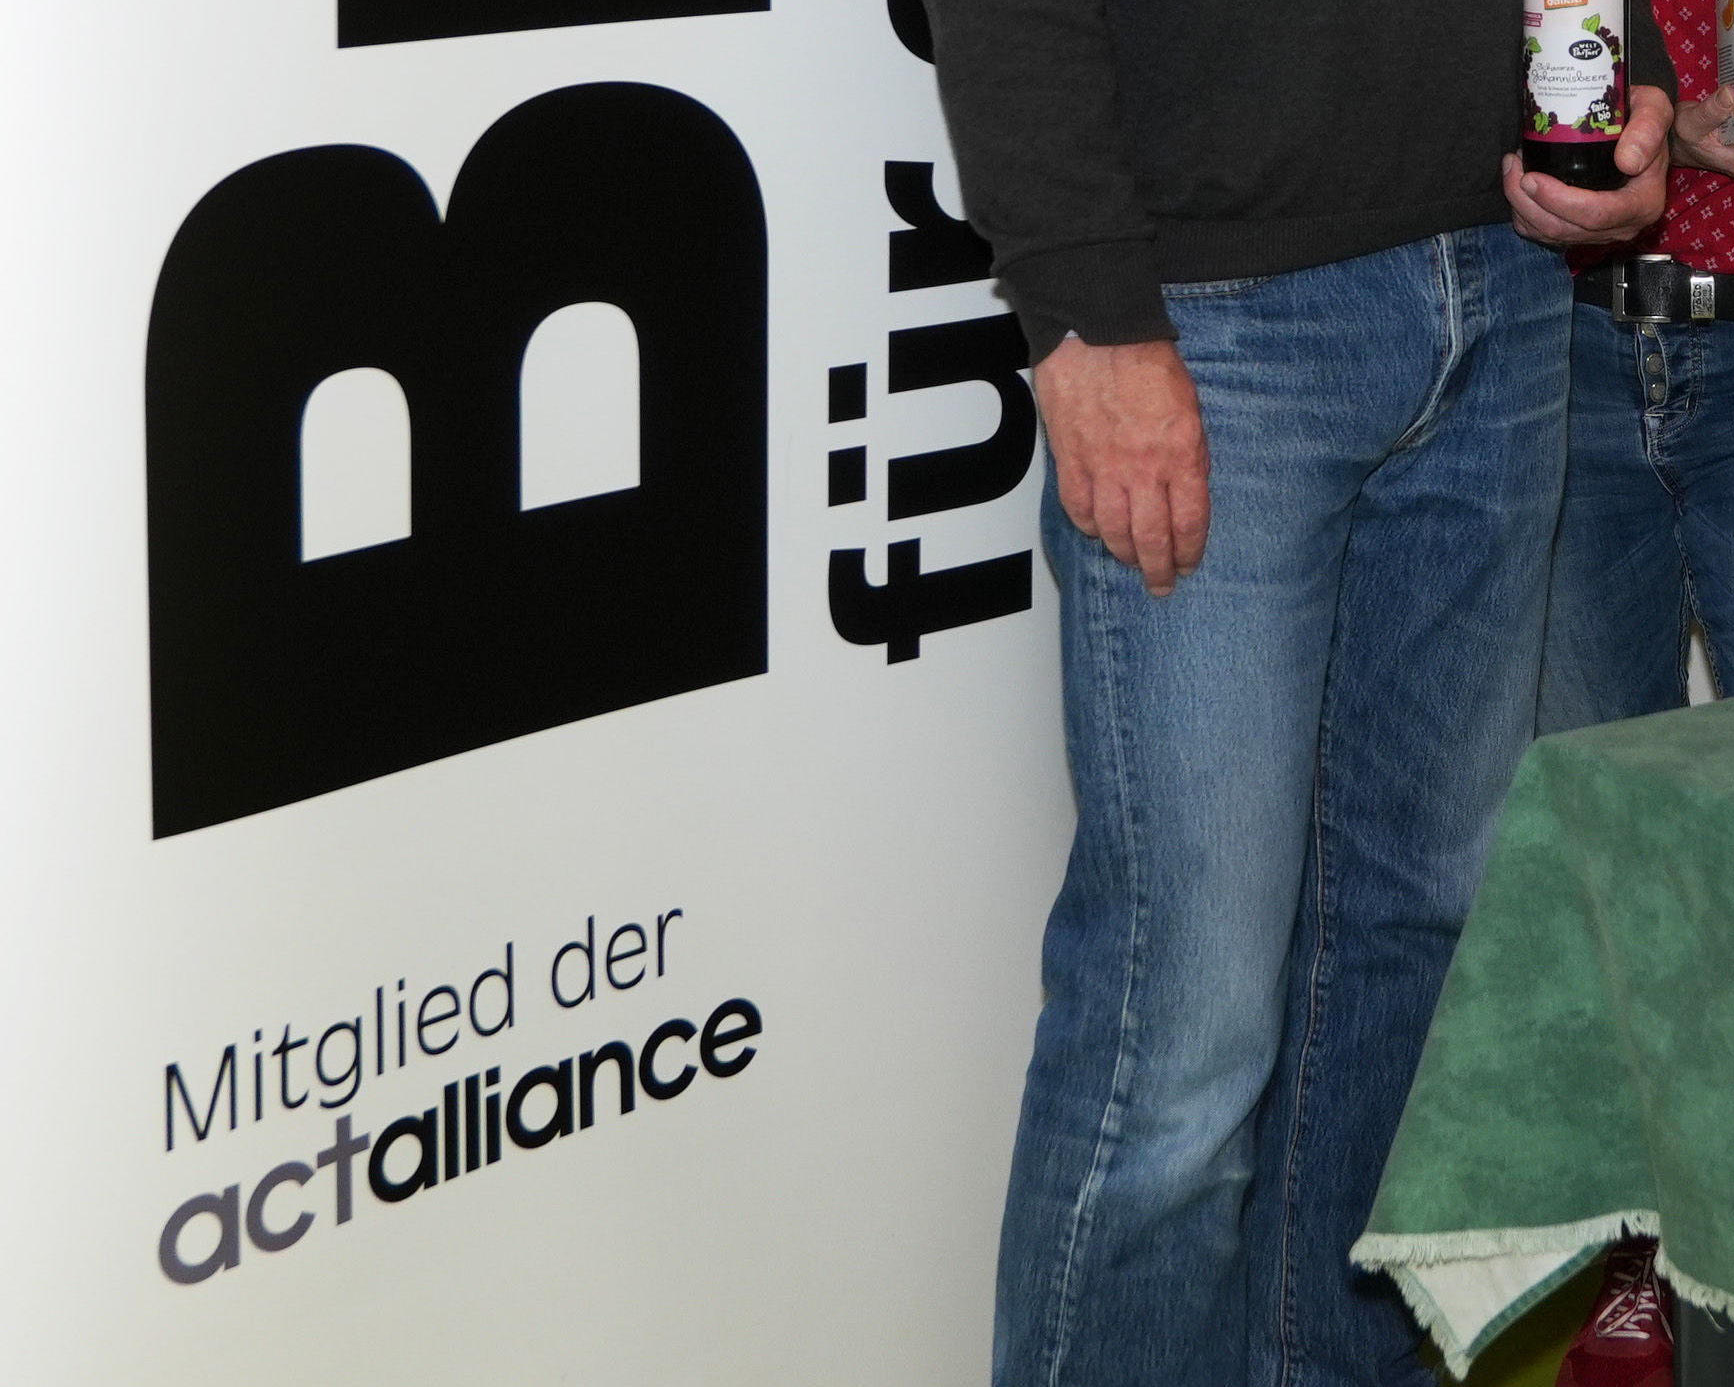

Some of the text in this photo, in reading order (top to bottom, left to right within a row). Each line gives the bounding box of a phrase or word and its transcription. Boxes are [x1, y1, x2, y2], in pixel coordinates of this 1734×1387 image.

[1597, 110, 1611, 122] bio
[828, 159, 1039, 665] für
[156, 996, 764, 1285] actalliance
[163, 907, 684, 1153] Mitglied der
